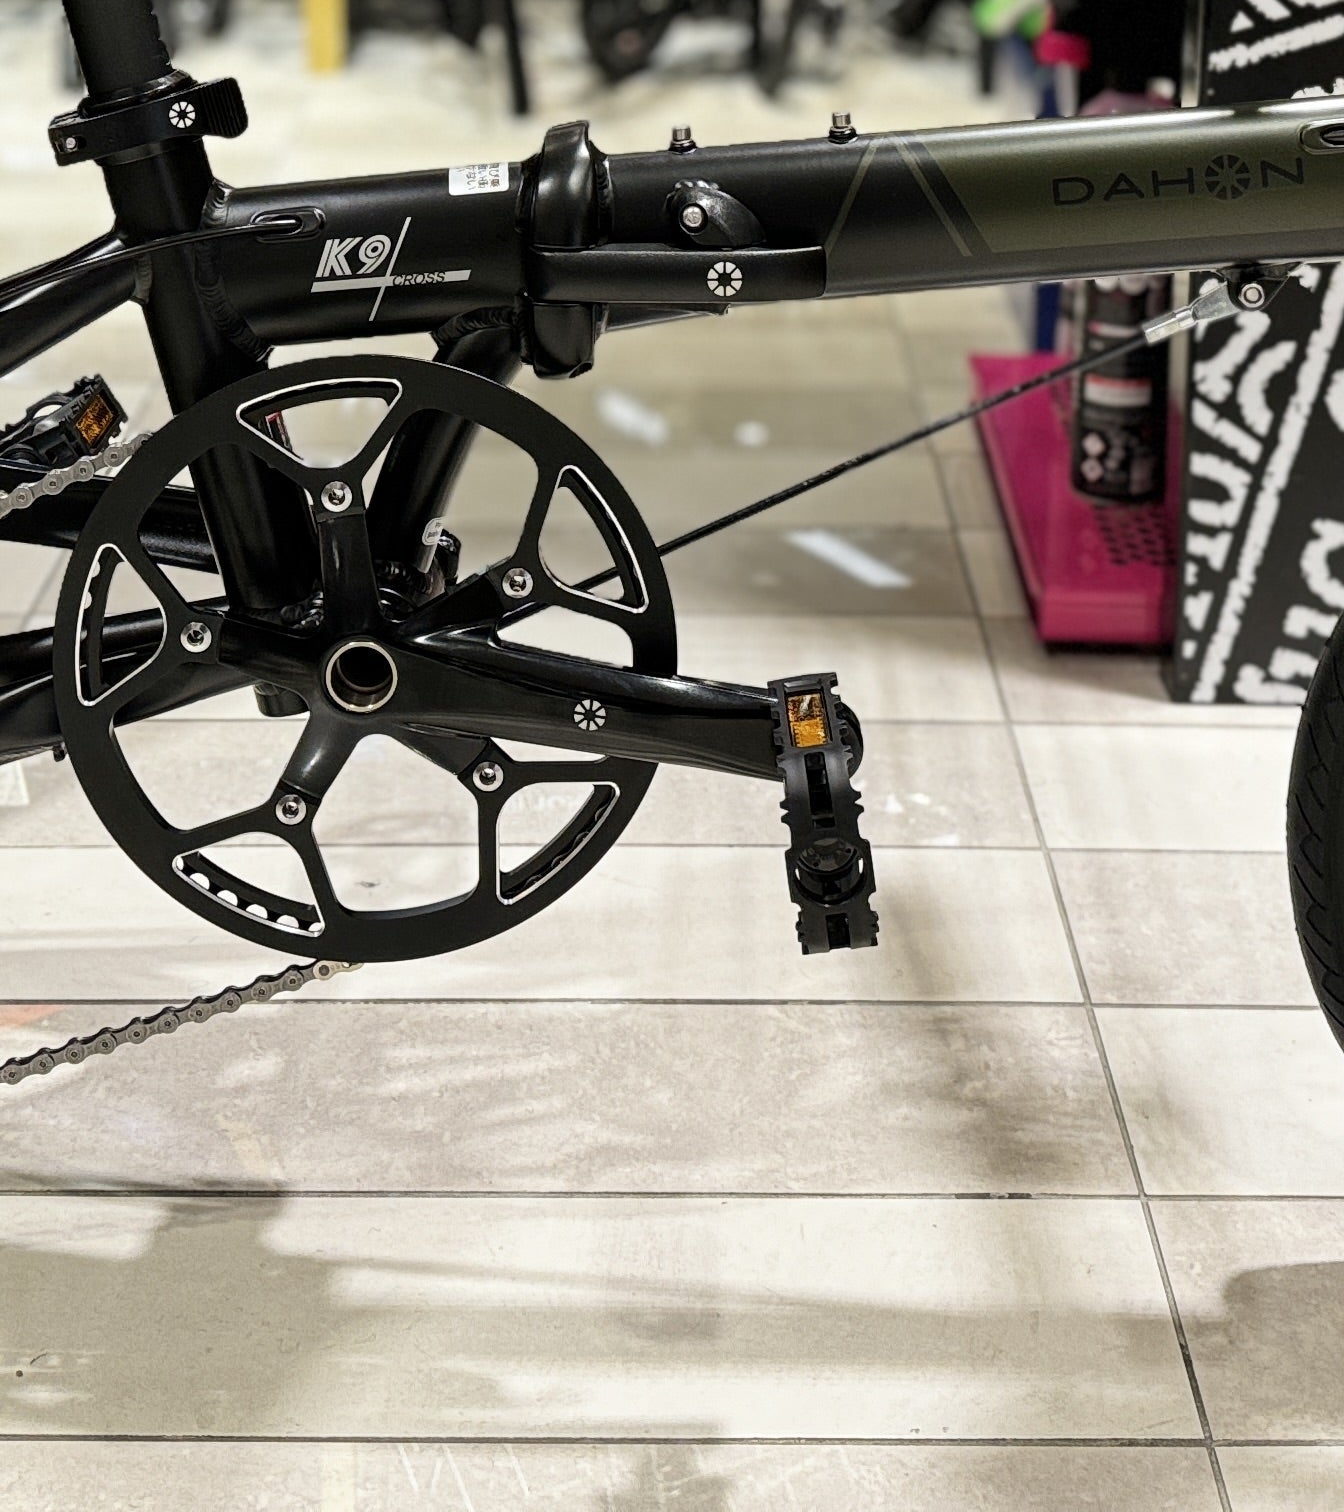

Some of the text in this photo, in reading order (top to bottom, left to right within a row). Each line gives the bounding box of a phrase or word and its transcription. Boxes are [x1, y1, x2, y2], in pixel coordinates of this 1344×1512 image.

[1052, 155, 1305, 206] DAHON
[314, 234, 392, 278] K9
[392, 271, 446, 286] CROSS
